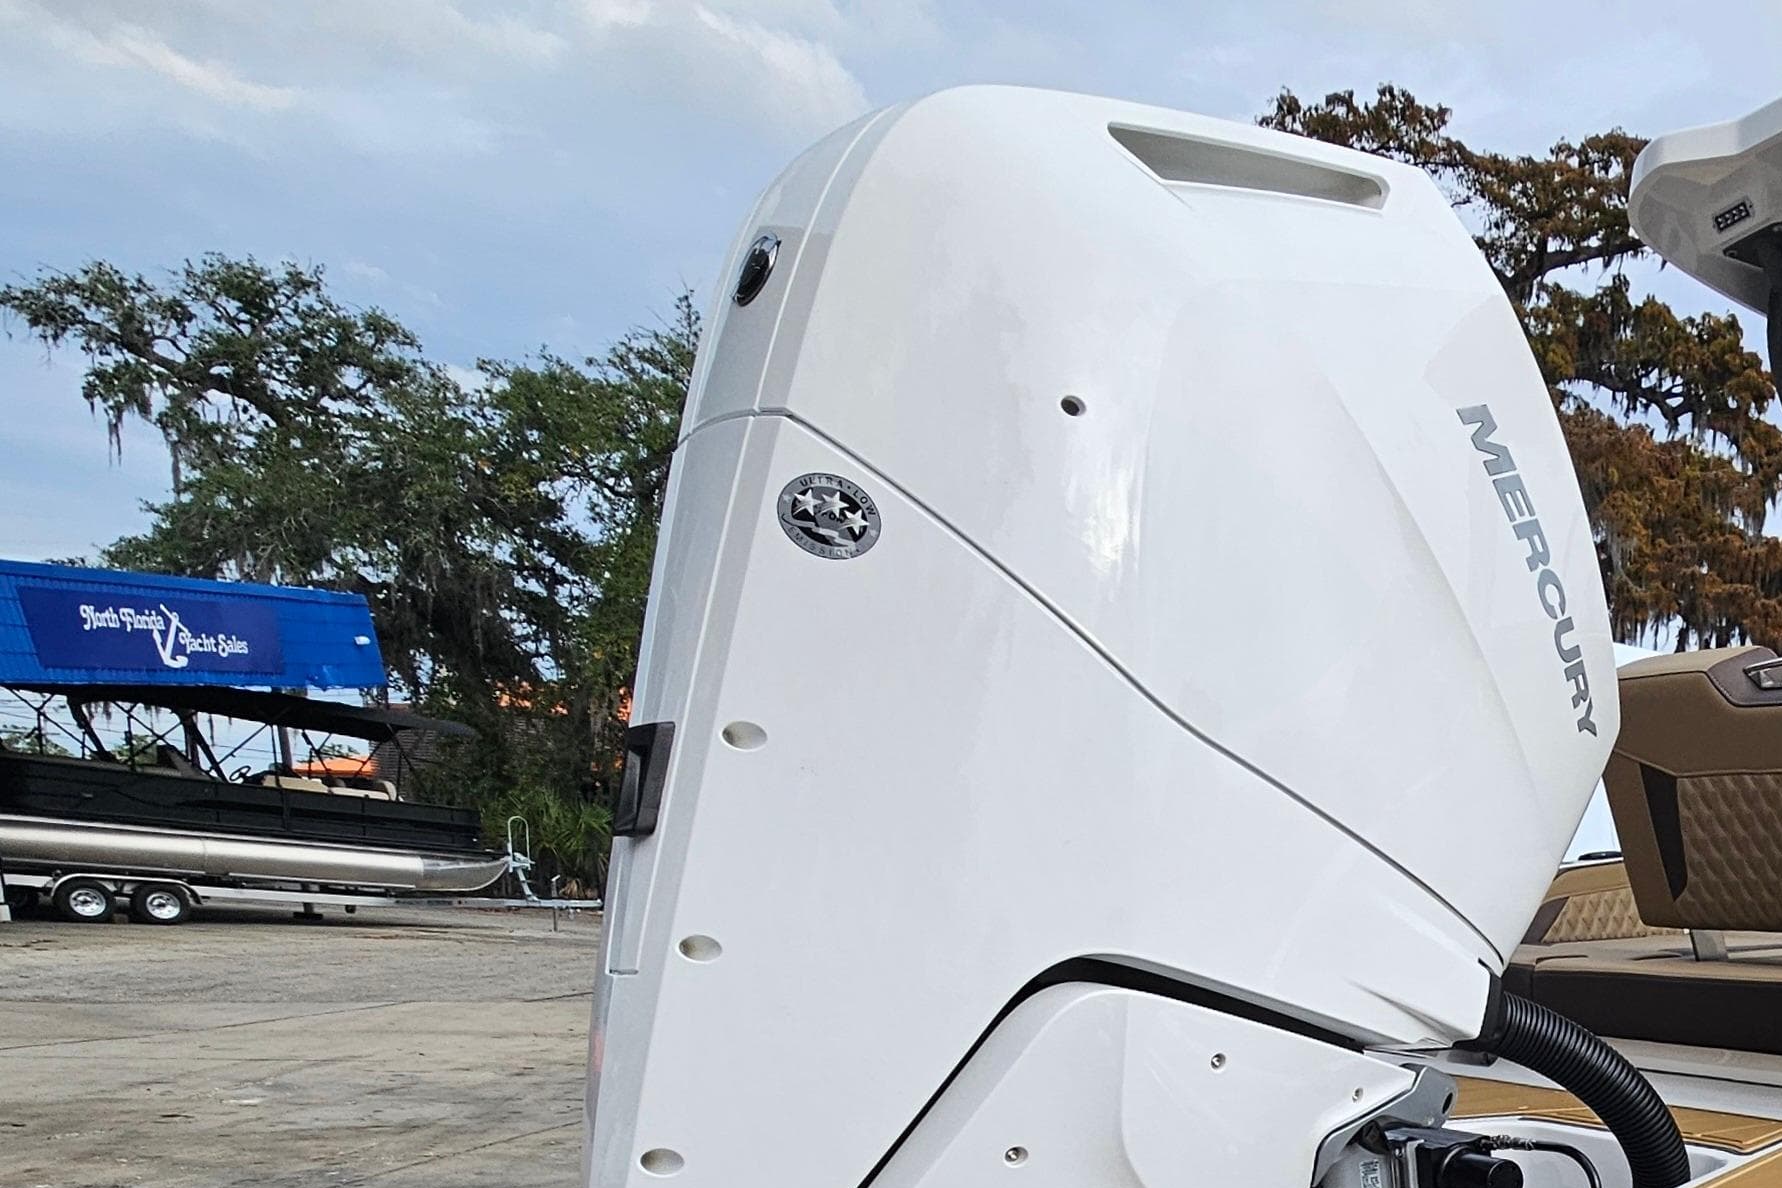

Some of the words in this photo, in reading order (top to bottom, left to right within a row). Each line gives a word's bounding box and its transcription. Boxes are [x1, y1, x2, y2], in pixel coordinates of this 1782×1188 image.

[800, 476, 843, 488] ULTRA
[853, 490, 876, 516] LOW
[1456, 404, 1598, 738] MERCURY
[79, 604, 120, 630] North
[119, 608, 165, 631] Florida
[178, 632, 217, 654] Yacht
[218, 634, 249, 657] Sales
